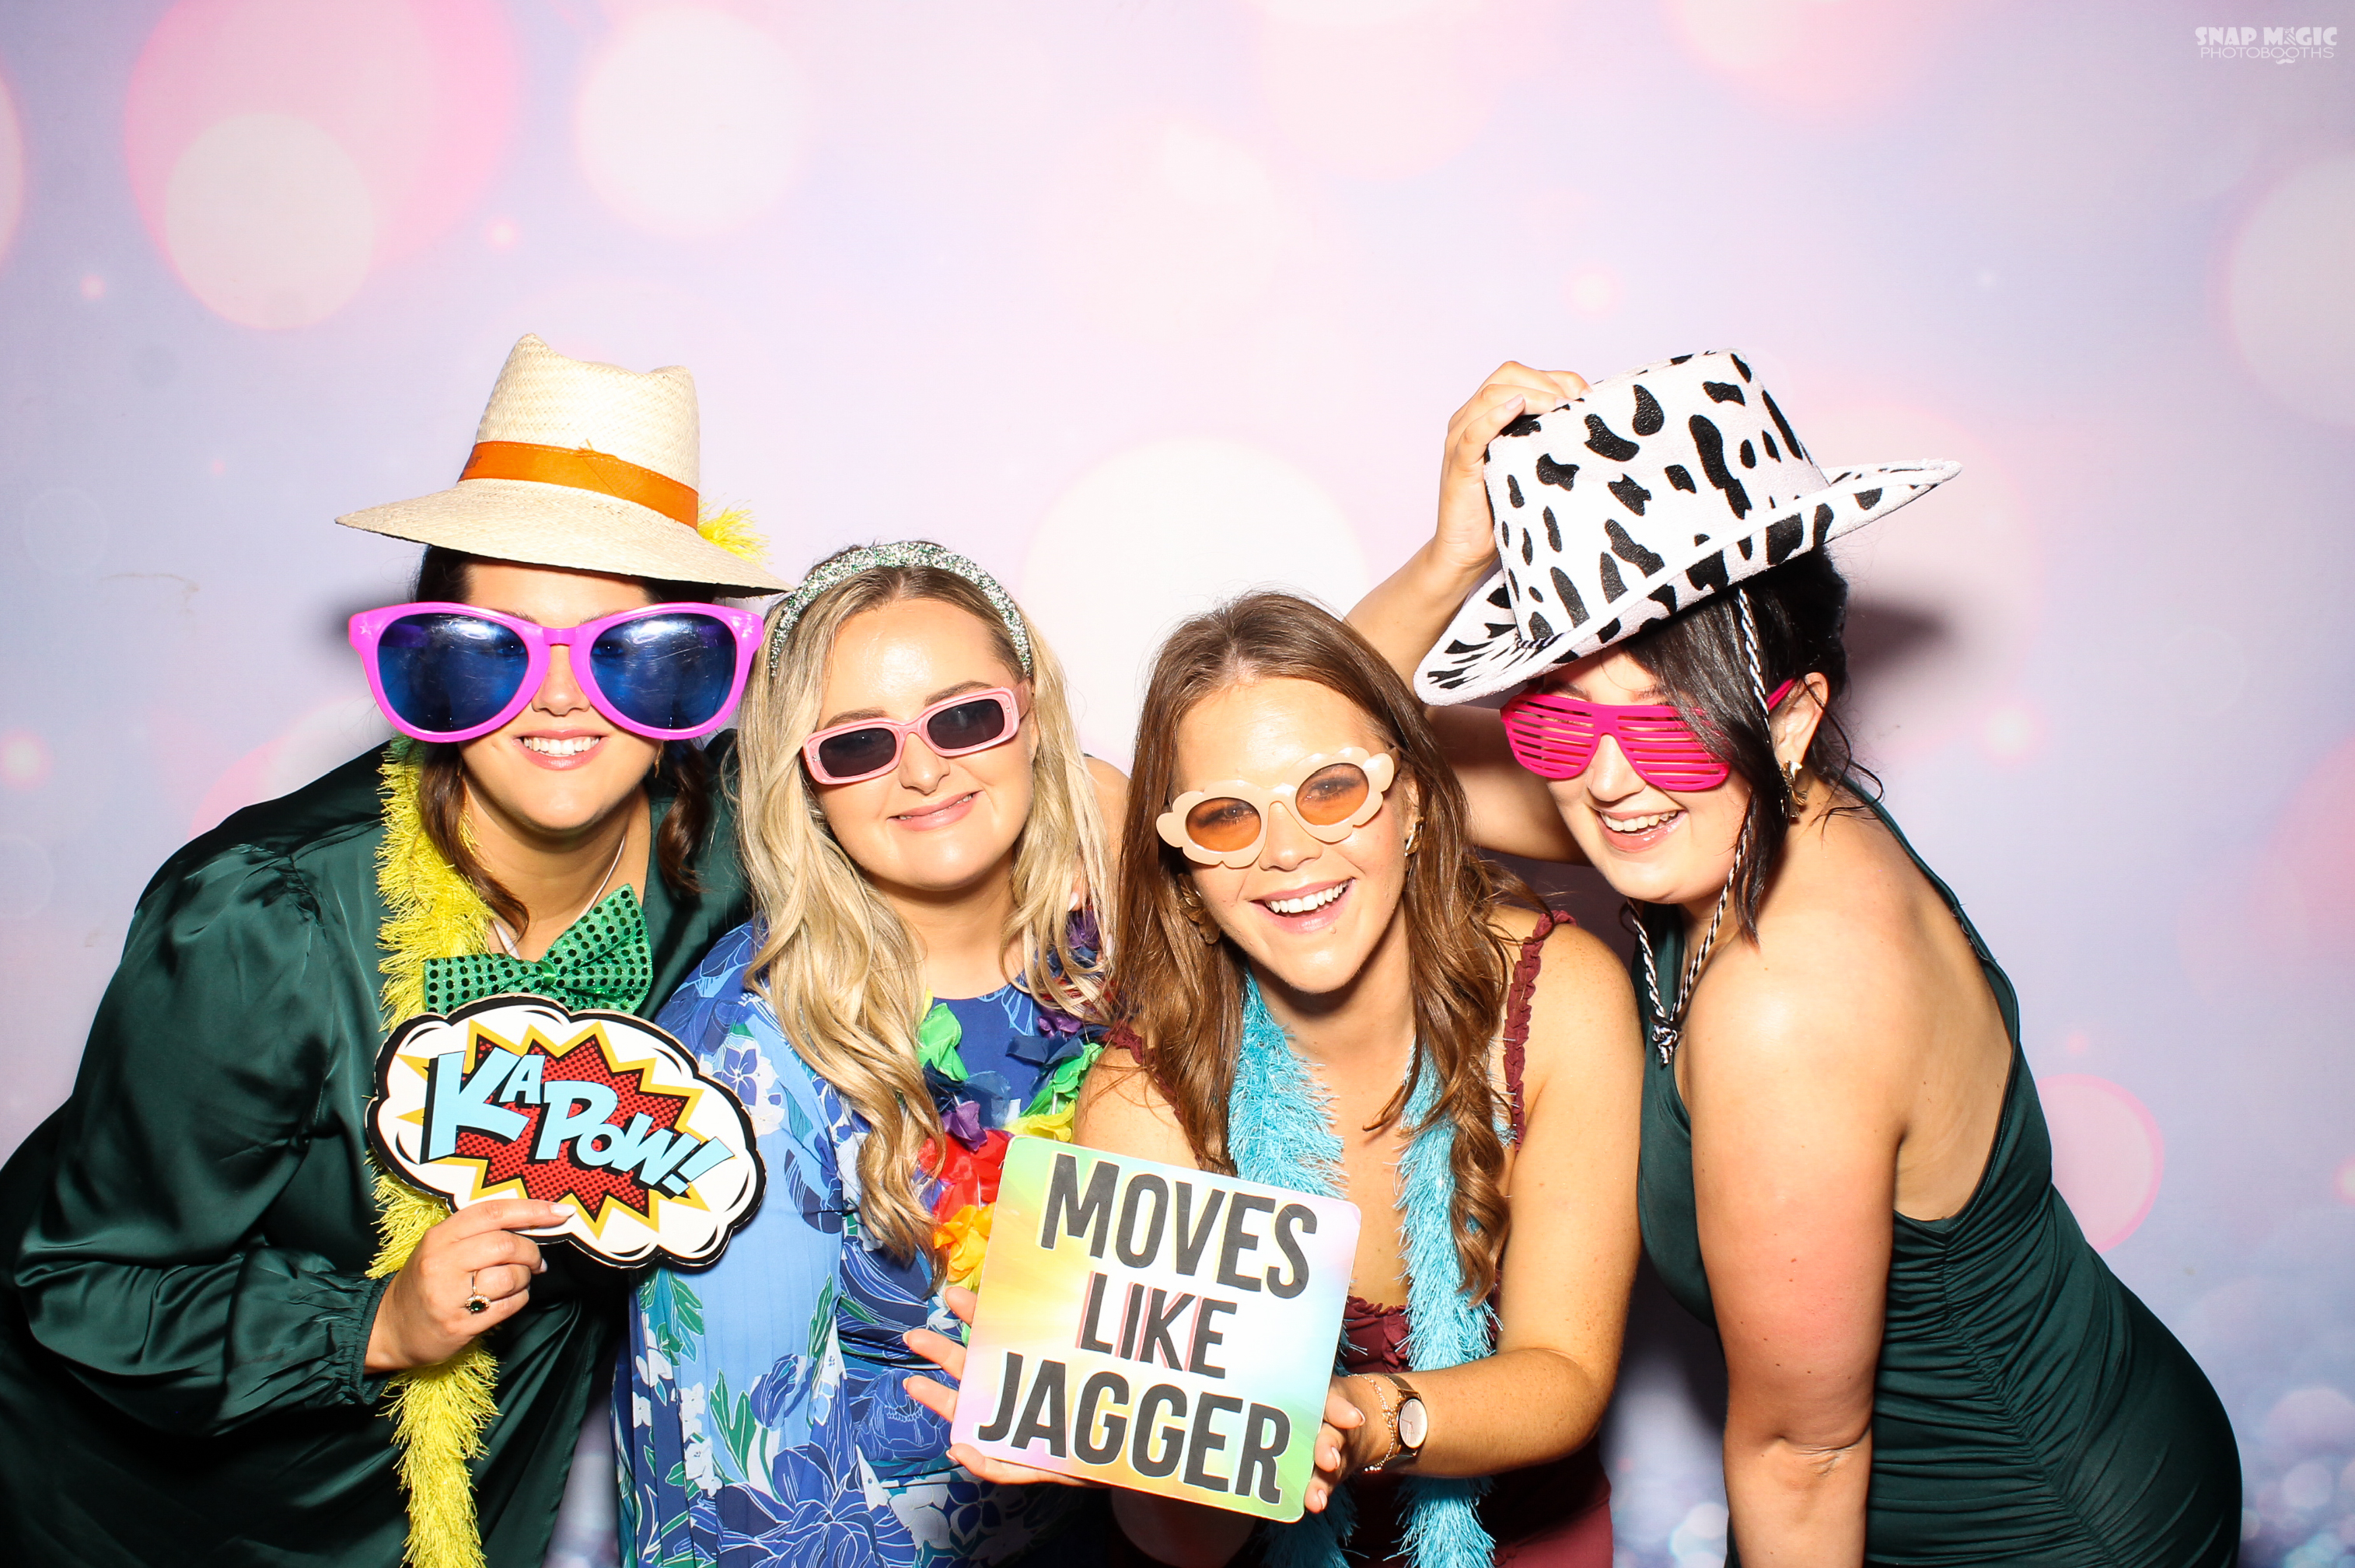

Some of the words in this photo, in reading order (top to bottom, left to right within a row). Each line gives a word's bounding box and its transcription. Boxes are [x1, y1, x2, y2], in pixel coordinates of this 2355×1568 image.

[1039, 1153, 1317, 1299] MOVES
[1076, 1271, 1237, 1380] LIKE
[977, 1351, 1291, 1504] JAGGER
